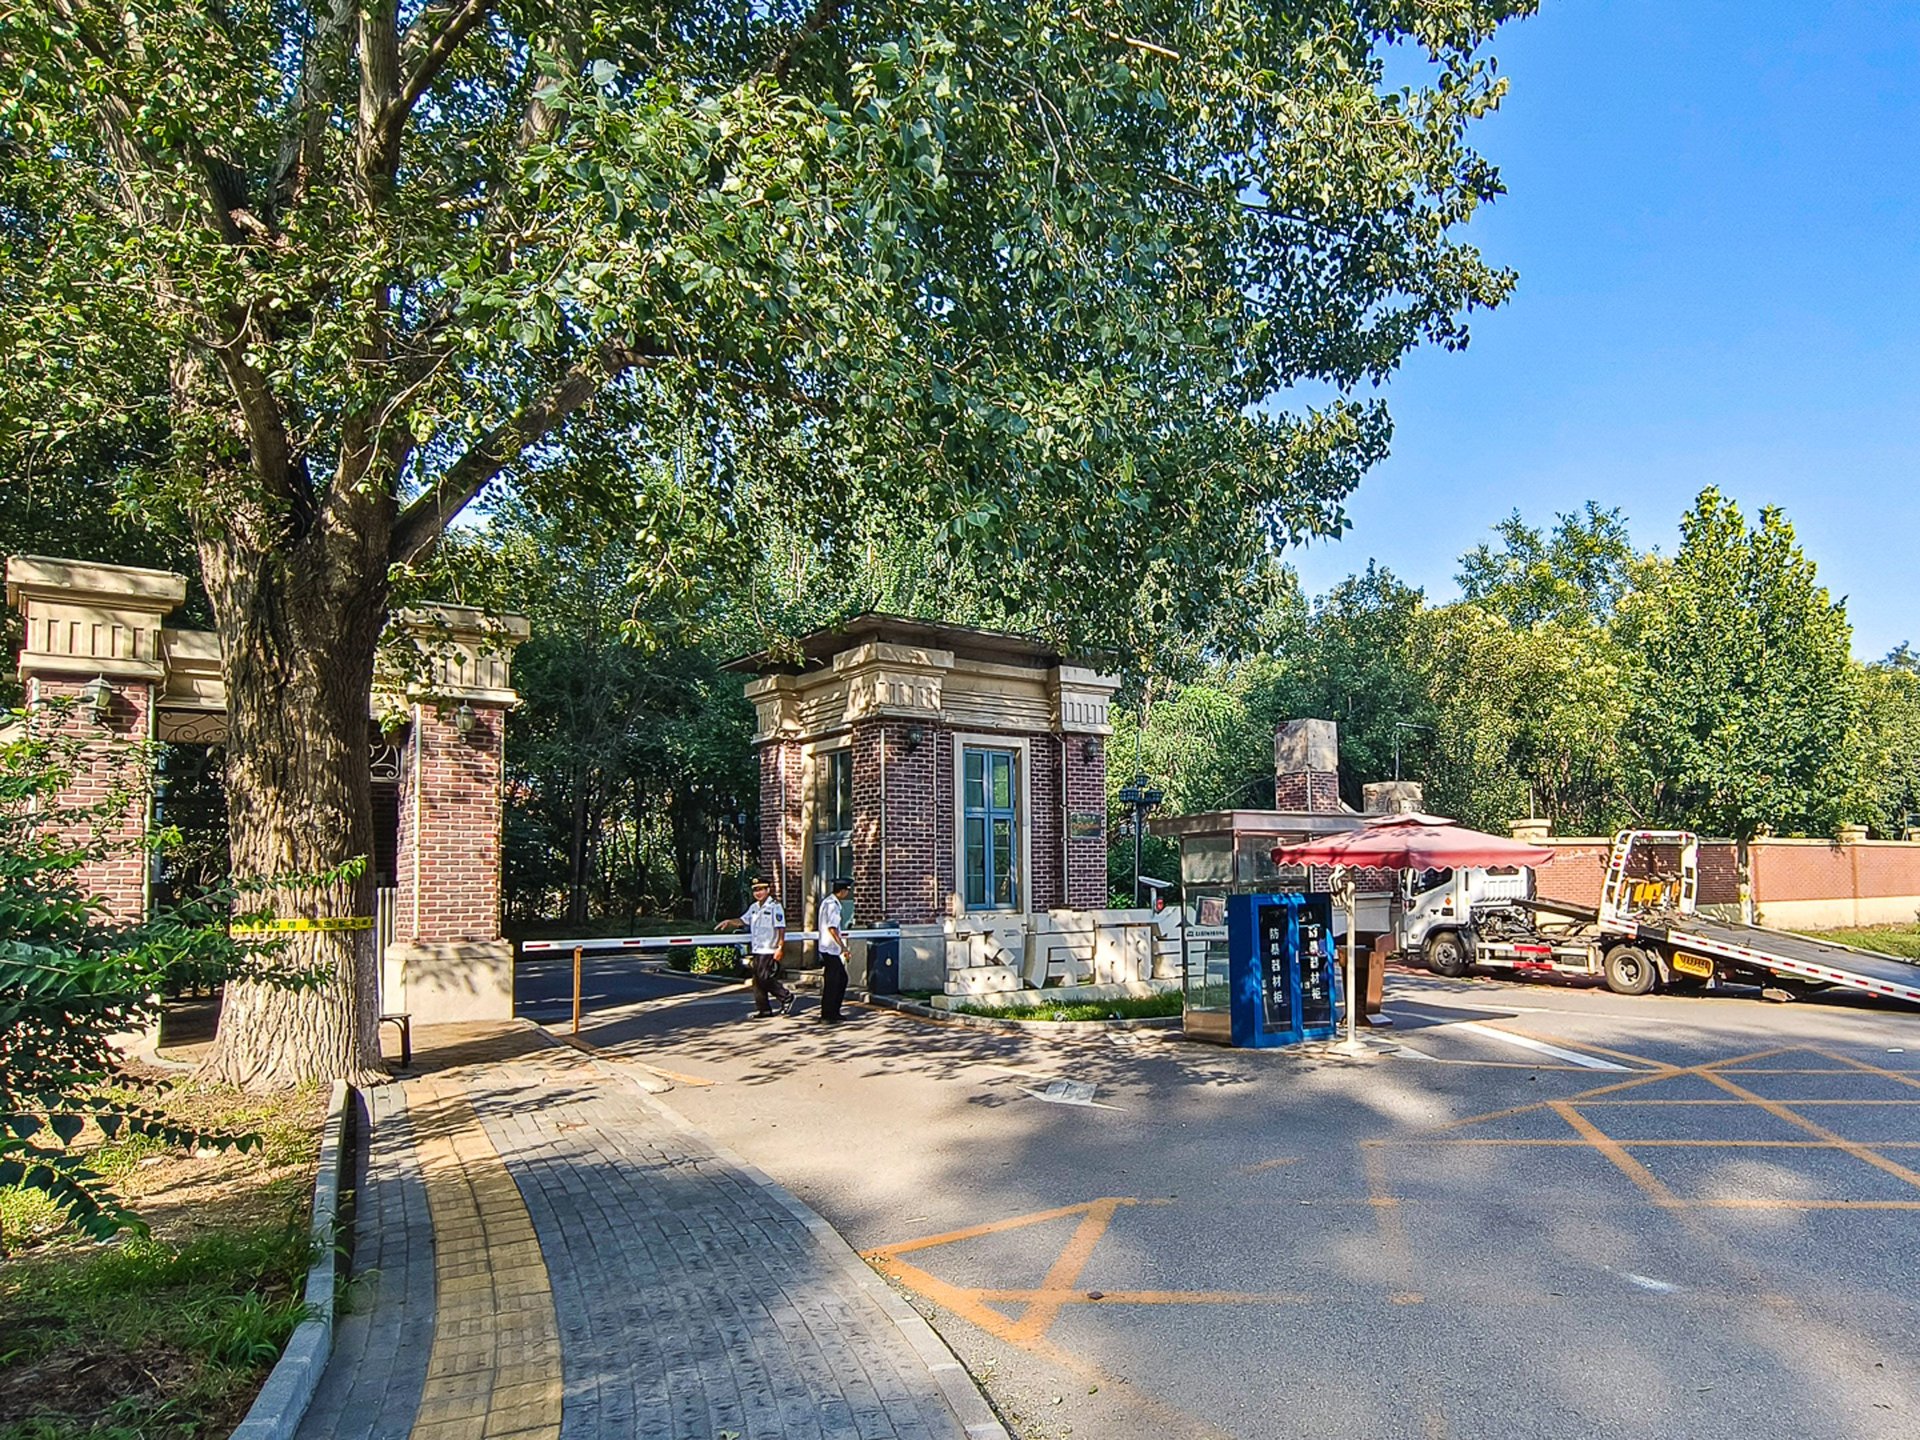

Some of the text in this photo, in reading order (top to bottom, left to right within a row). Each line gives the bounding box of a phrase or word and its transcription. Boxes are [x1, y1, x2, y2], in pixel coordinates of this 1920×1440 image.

[1269, 927, 1283, 1004] 防暴器材柜
[1308, 927, 1322, 1001] 防暴器材柜
